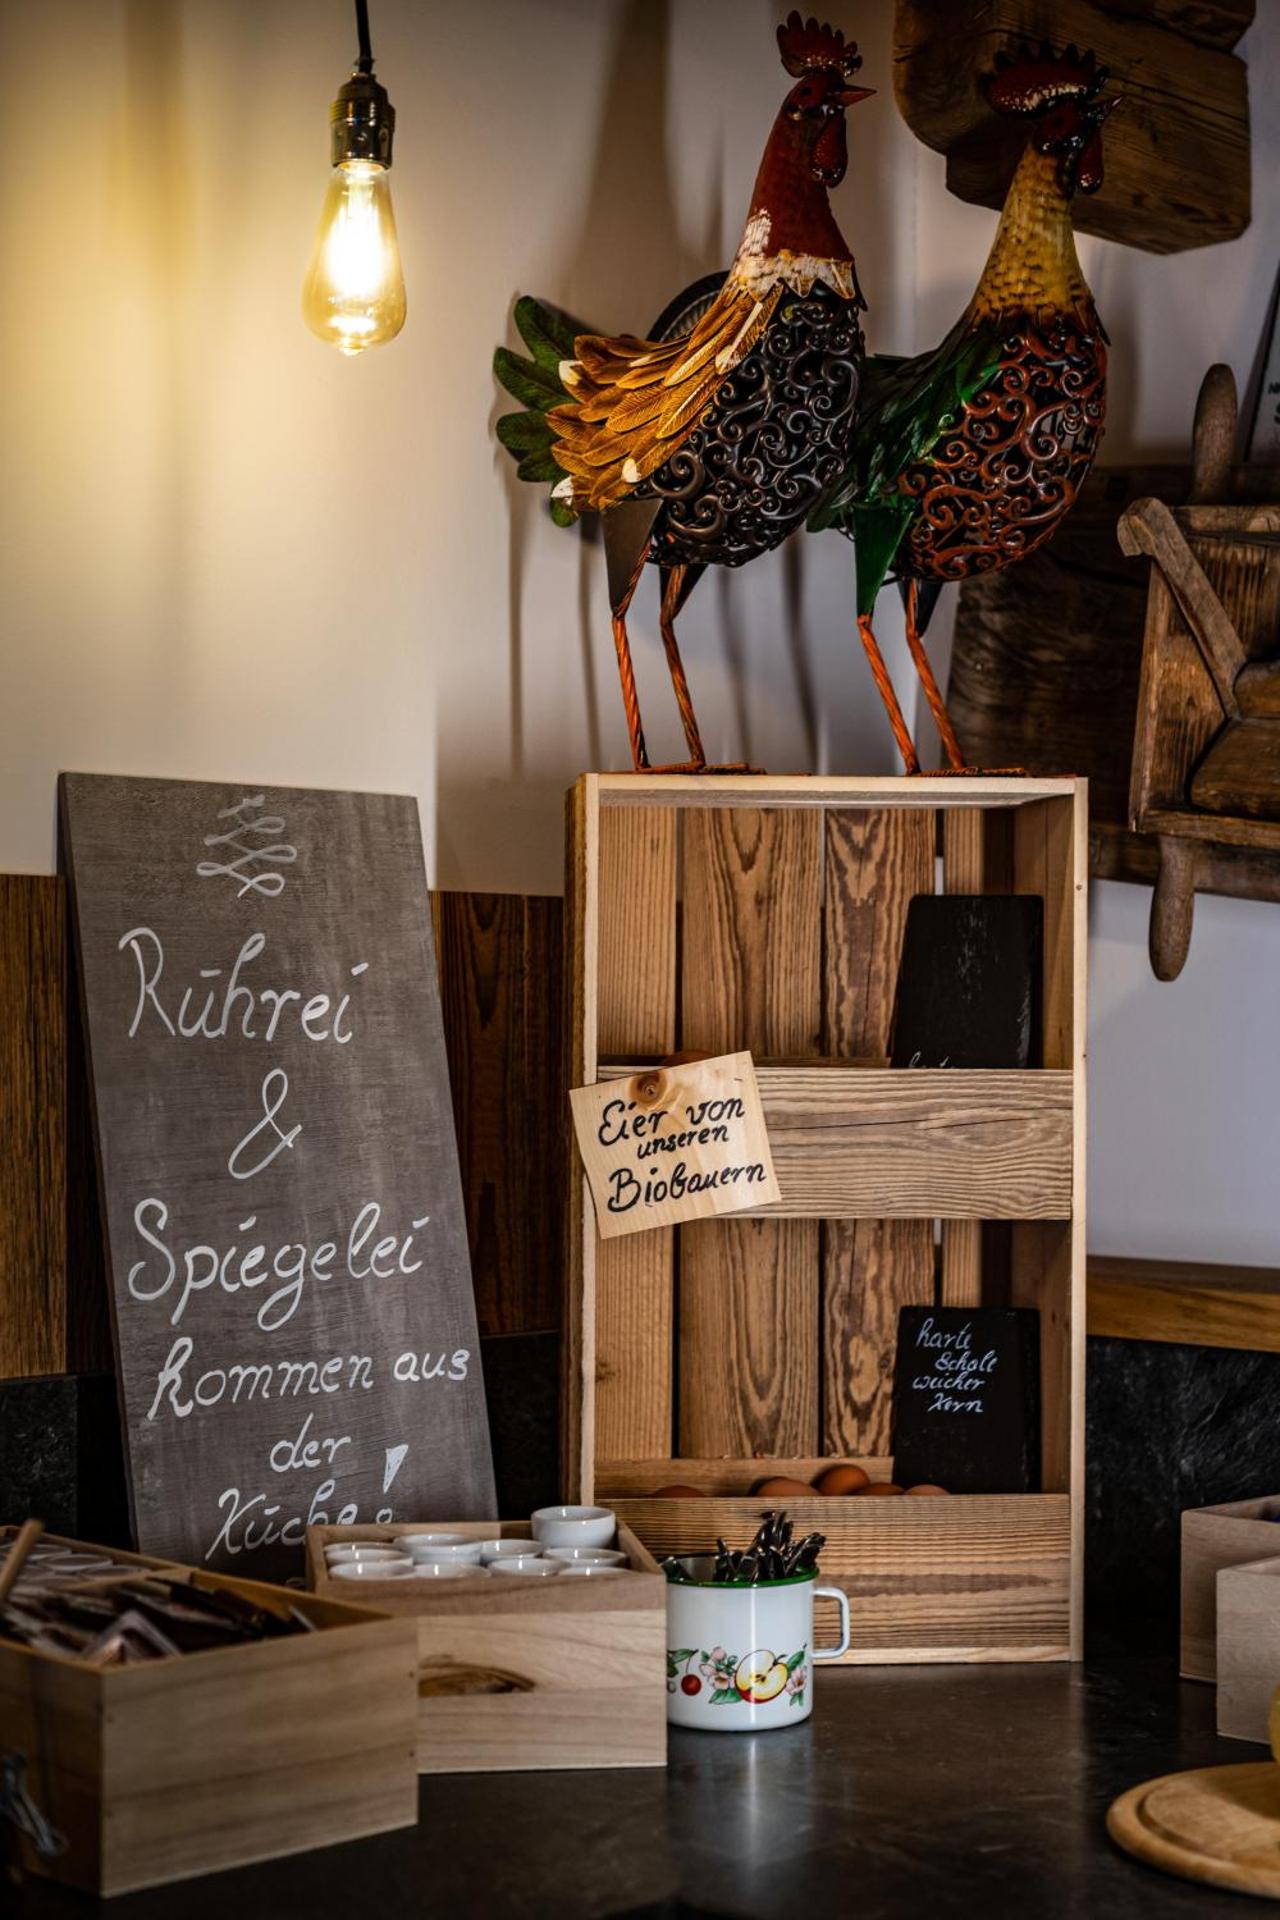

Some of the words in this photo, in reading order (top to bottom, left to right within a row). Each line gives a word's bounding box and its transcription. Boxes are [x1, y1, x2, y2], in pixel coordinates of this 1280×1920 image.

[118, 926, 369, 1044] Rührei
[227, 1067, 303, 1180] &
[597, 1099, 669, 1147] Eier
[685, 1096, 746, 1126] von
[636, 1123, 730, 1160] unseren
[606, 1161, 767, 1214] Biobauern
[127, 1197, 430, 1332] Spiegelei
[392, 1348, 471, 1381] aus
[268, 1411, 352, 1473] der
